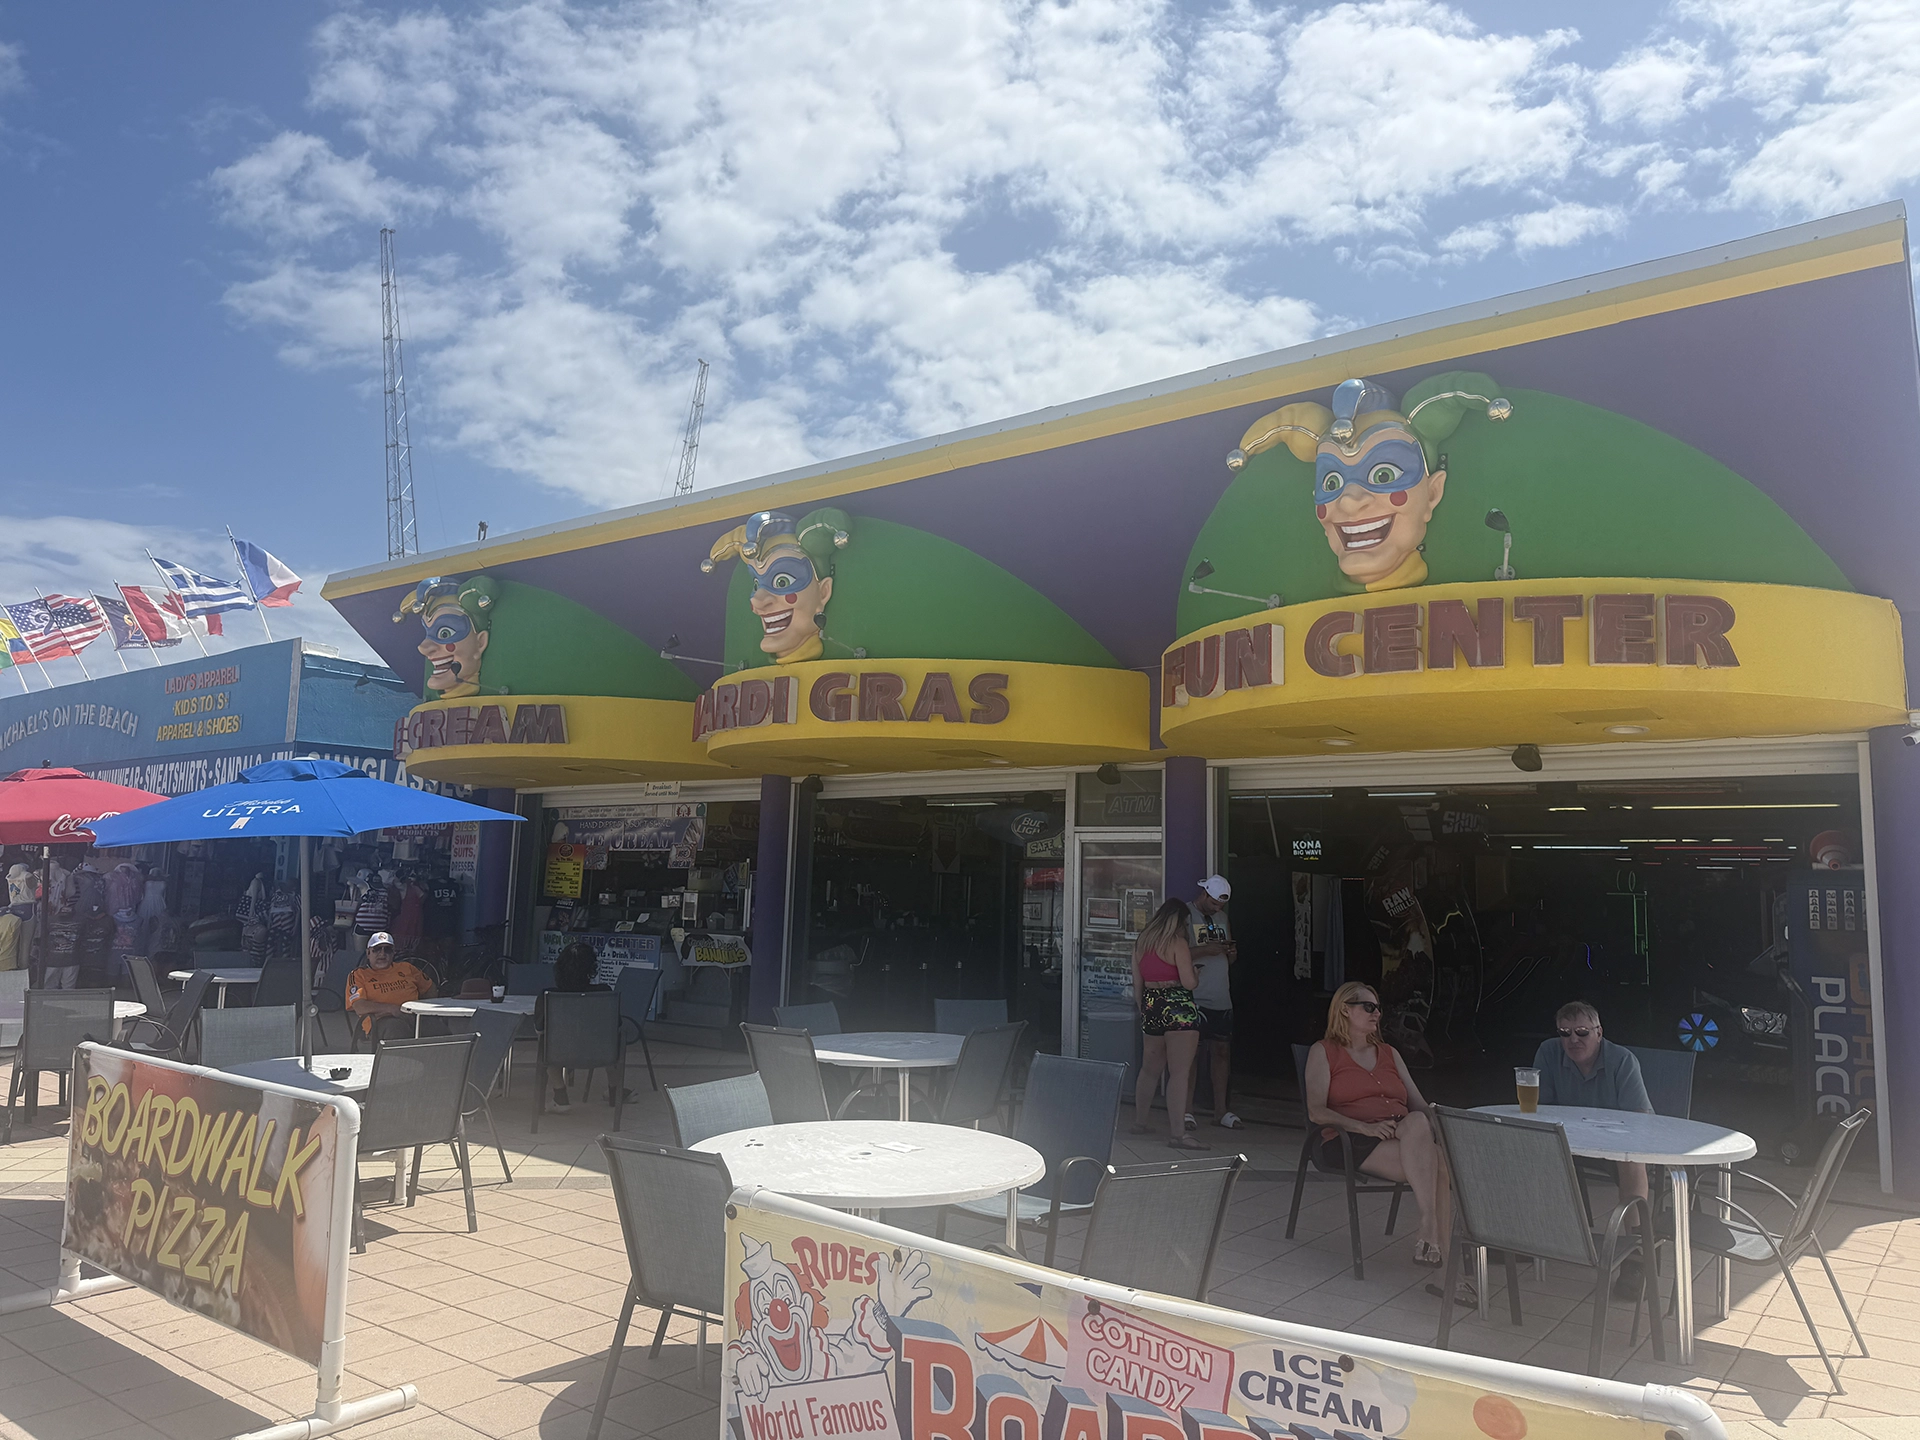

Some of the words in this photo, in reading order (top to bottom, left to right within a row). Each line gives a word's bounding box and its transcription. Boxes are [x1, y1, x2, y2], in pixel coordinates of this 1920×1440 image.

[1162, 622, 1284, 708] FUN
[1304, 593, 1740, 679] CENTER
[198, 666, 238, 689] APPAREL
[53, 705, 70, 728] ON
[75, 703, 95, 725] THE
[99, 705, 138, 737] BEACH
[692, 676, 798, 742] ARDI
[808, 672, 1010, 725] GRAS
[157, 722, 194, 741] APPAREL
[197, 720, 204, 737] &
[206, 715, 240, 735] SHOES
[408, 704, 567, 749] CREAM
[144, 759, 207, 793] SWEATSHIRTS
[202, 805, 300, 818] ULTRA
[1108, 796, 1155, 813] ATM
[455, 834, 477, 845] SWIM
[1016, 825, 1041, 835] LIGH
[1030, 839, 1054, 854] SAFE
[1293, 840, 1321, 850] KONA
[434, 889, 457, 898] USA
[1382, 886, 1412, 910] RAW
[1388, 896, 1416, 918] THRILLS
[607, 937, 656, 950] CENTER
[695, 947, 747, 964] BANANAS
[1084, 965, 1101, 973] FUN
[1104, 966, 1132, 975] CENTE
[373, 980, 408, 990] Emirates
[1811, 976, 1850, 1115] PLACE
[82, 1076, 320, 1218] BOARDWALK
[123, 1179, 249, 1295] PIZZA
[790, 1236, 881, 1289] RIDES
[1082, 1312, 1213, 1383] COTTON
[1086, 1348, 1195, 1412] CANDY
[1272, 1349, 1344, 1387] ICE
[1239, 1370, 1384, 1434] CREAM
[745, 1399, 804, 1440] World
[805, 1397, 888, 1437] Famous
